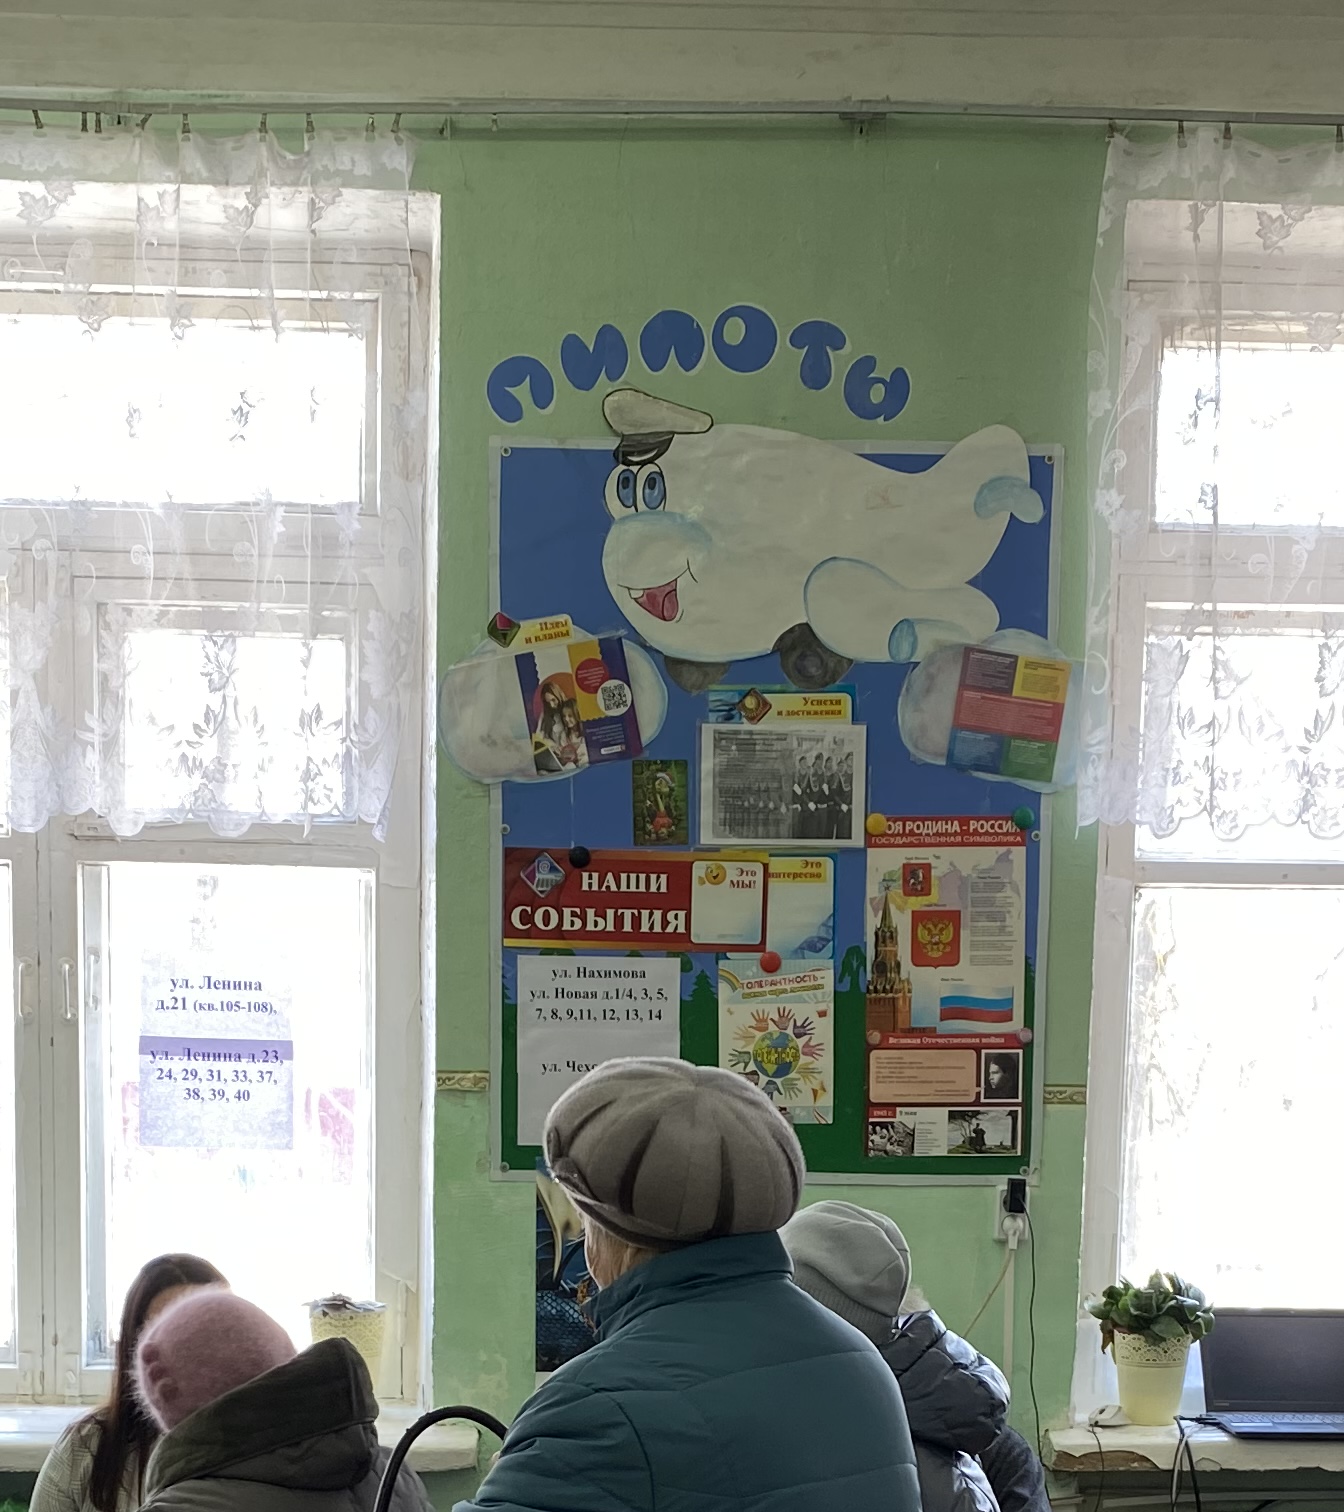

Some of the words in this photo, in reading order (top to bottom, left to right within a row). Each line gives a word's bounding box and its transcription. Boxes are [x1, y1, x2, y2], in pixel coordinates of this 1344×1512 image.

[803, 697, 841, 706] Успехи
[886, 820, 903, 833] ОЯ
[906, 820, 960, 836] РОДИНА
[871, 836, 961, 844] ГОСУДАРСТВЕННАЯ
[963, 835, 1022, 843] СИМВОЛИКА
[736, 867, 757, 877] Это
[801, 860, 822, 869] Это
[581, 872, 668, 893] НАШИ
[729, 880, 757, 889] МЫ!
[510, 905, 687, 934] СОБЫТИЯ
[552, 969, 572, 981] ул.
[576, 967, 646, 979] Нахимова
[170, 978, 194, 992] ул.
[198, 976, 262, 991] Ленина
[739, 974, 818, 990] ТОЛЕРАНТНОСТЬ
[530, 989, 550, 1002] ул.
[554, 987, 598, 1000] Новая
[601, 988, 637, 1002] д.1/4,
[640, 988, 653, 1002] 3,
[656, 988, 668, 1002] 5,
[155, 997, 187, 1011] д.21
[193, 1000, 277, 1015] (кв.105-108),
[535, 1008, 547, 1022] 7,
[551, 1008, 563, 1022] 8,
[602, 1008, 621, 1023] 12,
[625, 1009, 643, 1023] 13,
[648, 1009, 662, 1021] 14
[150, 1050, 174, 1064] ул.
[178, 1047, 242, 1063] Ленина
[247, 1050, 284, 1066] д.23,
[542, 1062, 561, 1075] ул.
[156, 1068, 177, 1082] 24,
[181, 1068, 203, 1083] 29,
[206, 1069, 228, 1084] 31,
[231, 1070, 253, 1084] 33,
[256, 1070, 277, 1085] 37,
[183, 1088, 204, 1102] 38,
[208, 1088, 230, 1103] 39,
[233, 1089, 250, 1101] 40
